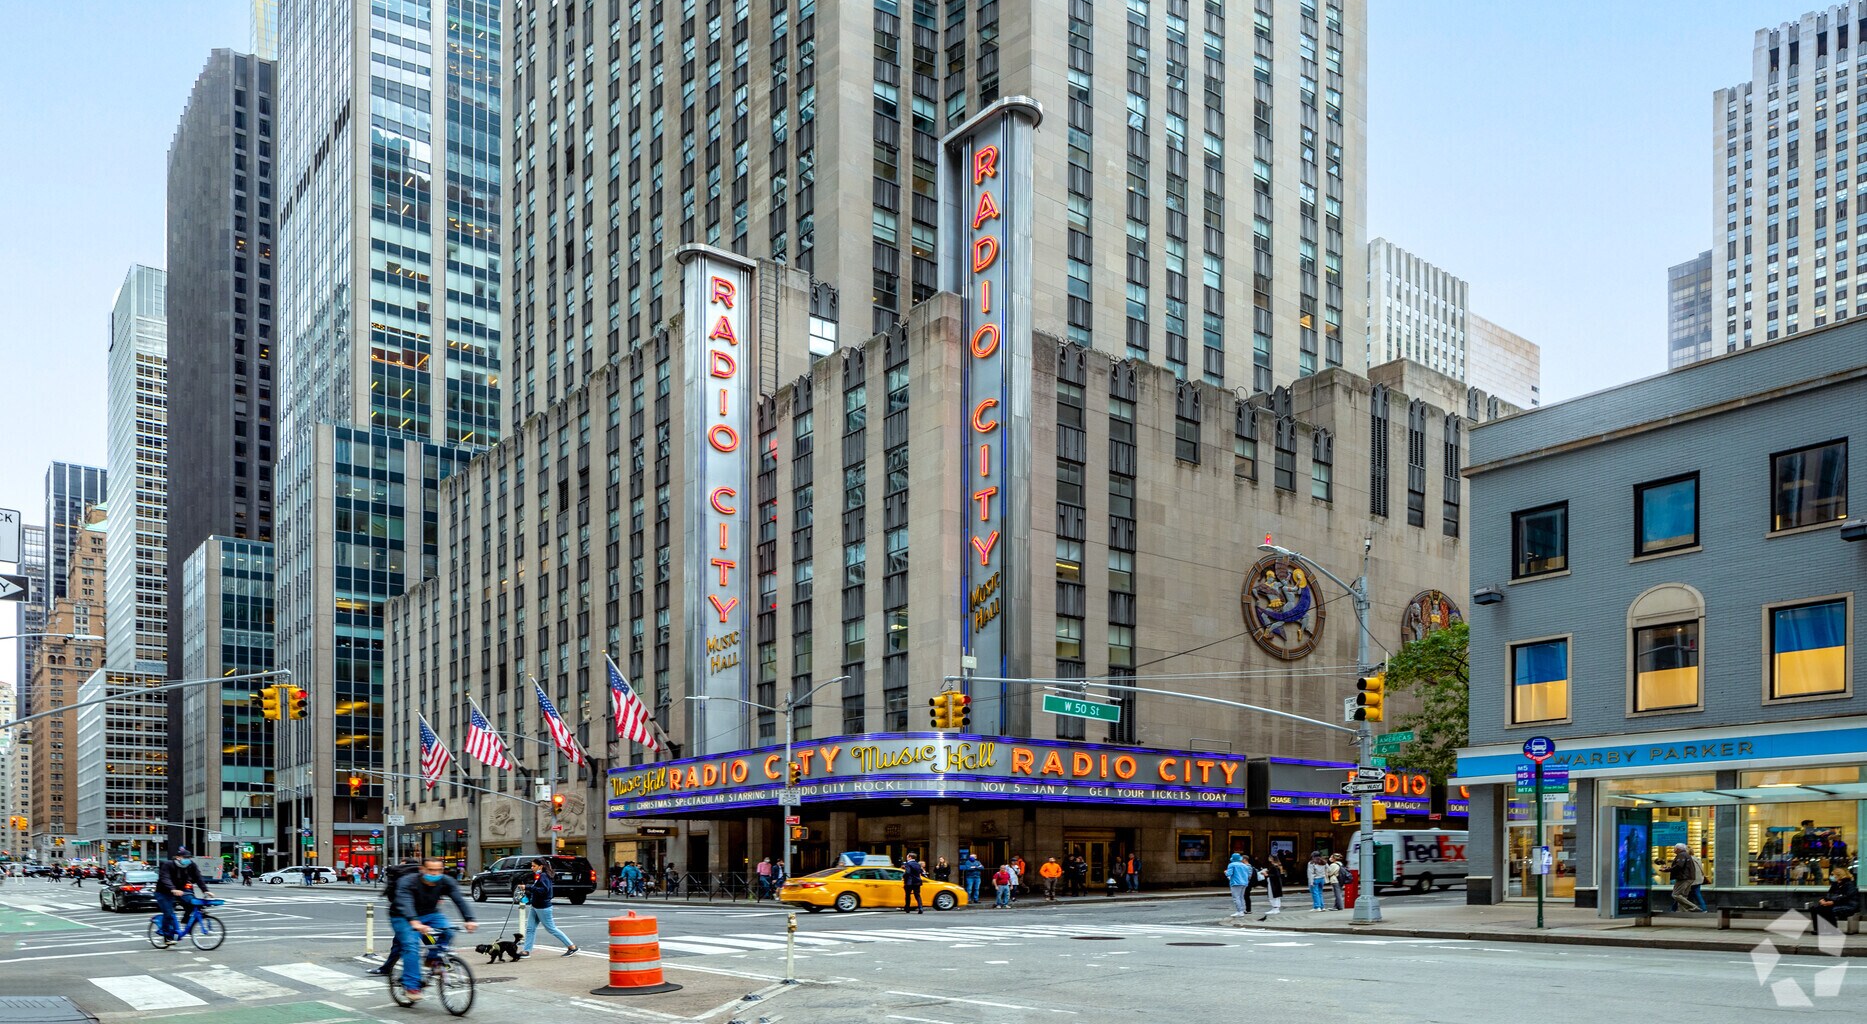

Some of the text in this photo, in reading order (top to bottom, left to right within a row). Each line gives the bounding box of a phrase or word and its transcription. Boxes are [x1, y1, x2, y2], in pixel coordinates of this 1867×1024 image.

[971, 145, 999, 566] RADIO CITY
[708, 275, 740, 623] RADIO CITY
[706, 630, 741, 656] MUSIC
[710, 652, 740, 675] HALL
[1064, 701, 1100, 716] W 50 St
[1379, 734, 1412, 744] AMERICAS
[1381, 745, 1388, 753] 6
[1553, 741, 1754, 767] WARBY PARKER
[668, 759, 749, 791] RADIO
[764, 745, 842, 780] CTY
[850, 744, 937, 773] Music
[930, 742, 998, 774] Hall
[1011, 747, 1138, 779] RADIO
[1158, 757, 1239, 785] CITY
[610, 804, 625, 812] CHASE
[636, 799, 672, 810] CHRISTMAS
[675, 795, 725, 806] SPECTACULAR
[728, 790, 766, 802] STARRING
[822, 783, 845, 794] CITY
[981, 782, 1006, 792] NOV
[1014, 784, 1021, 793] 5
[1032, 785, 1055, 794] JAN
[1062, 786, 1069, 795] 2
[1089, 787, 1109, 797] GET
[1117, 789, 1145, 798] YOUR
[1151, 790, 1191, 800] TICKETS
[1197, 792, 1227, 802] TODAY
[1270, 796, 1292, 804] CHASE
[1308, 797, 1333, 806] READY
[1394, 801, 1421, 810] MAGIC?
[1402, 835, 1467, 862] FedEx
